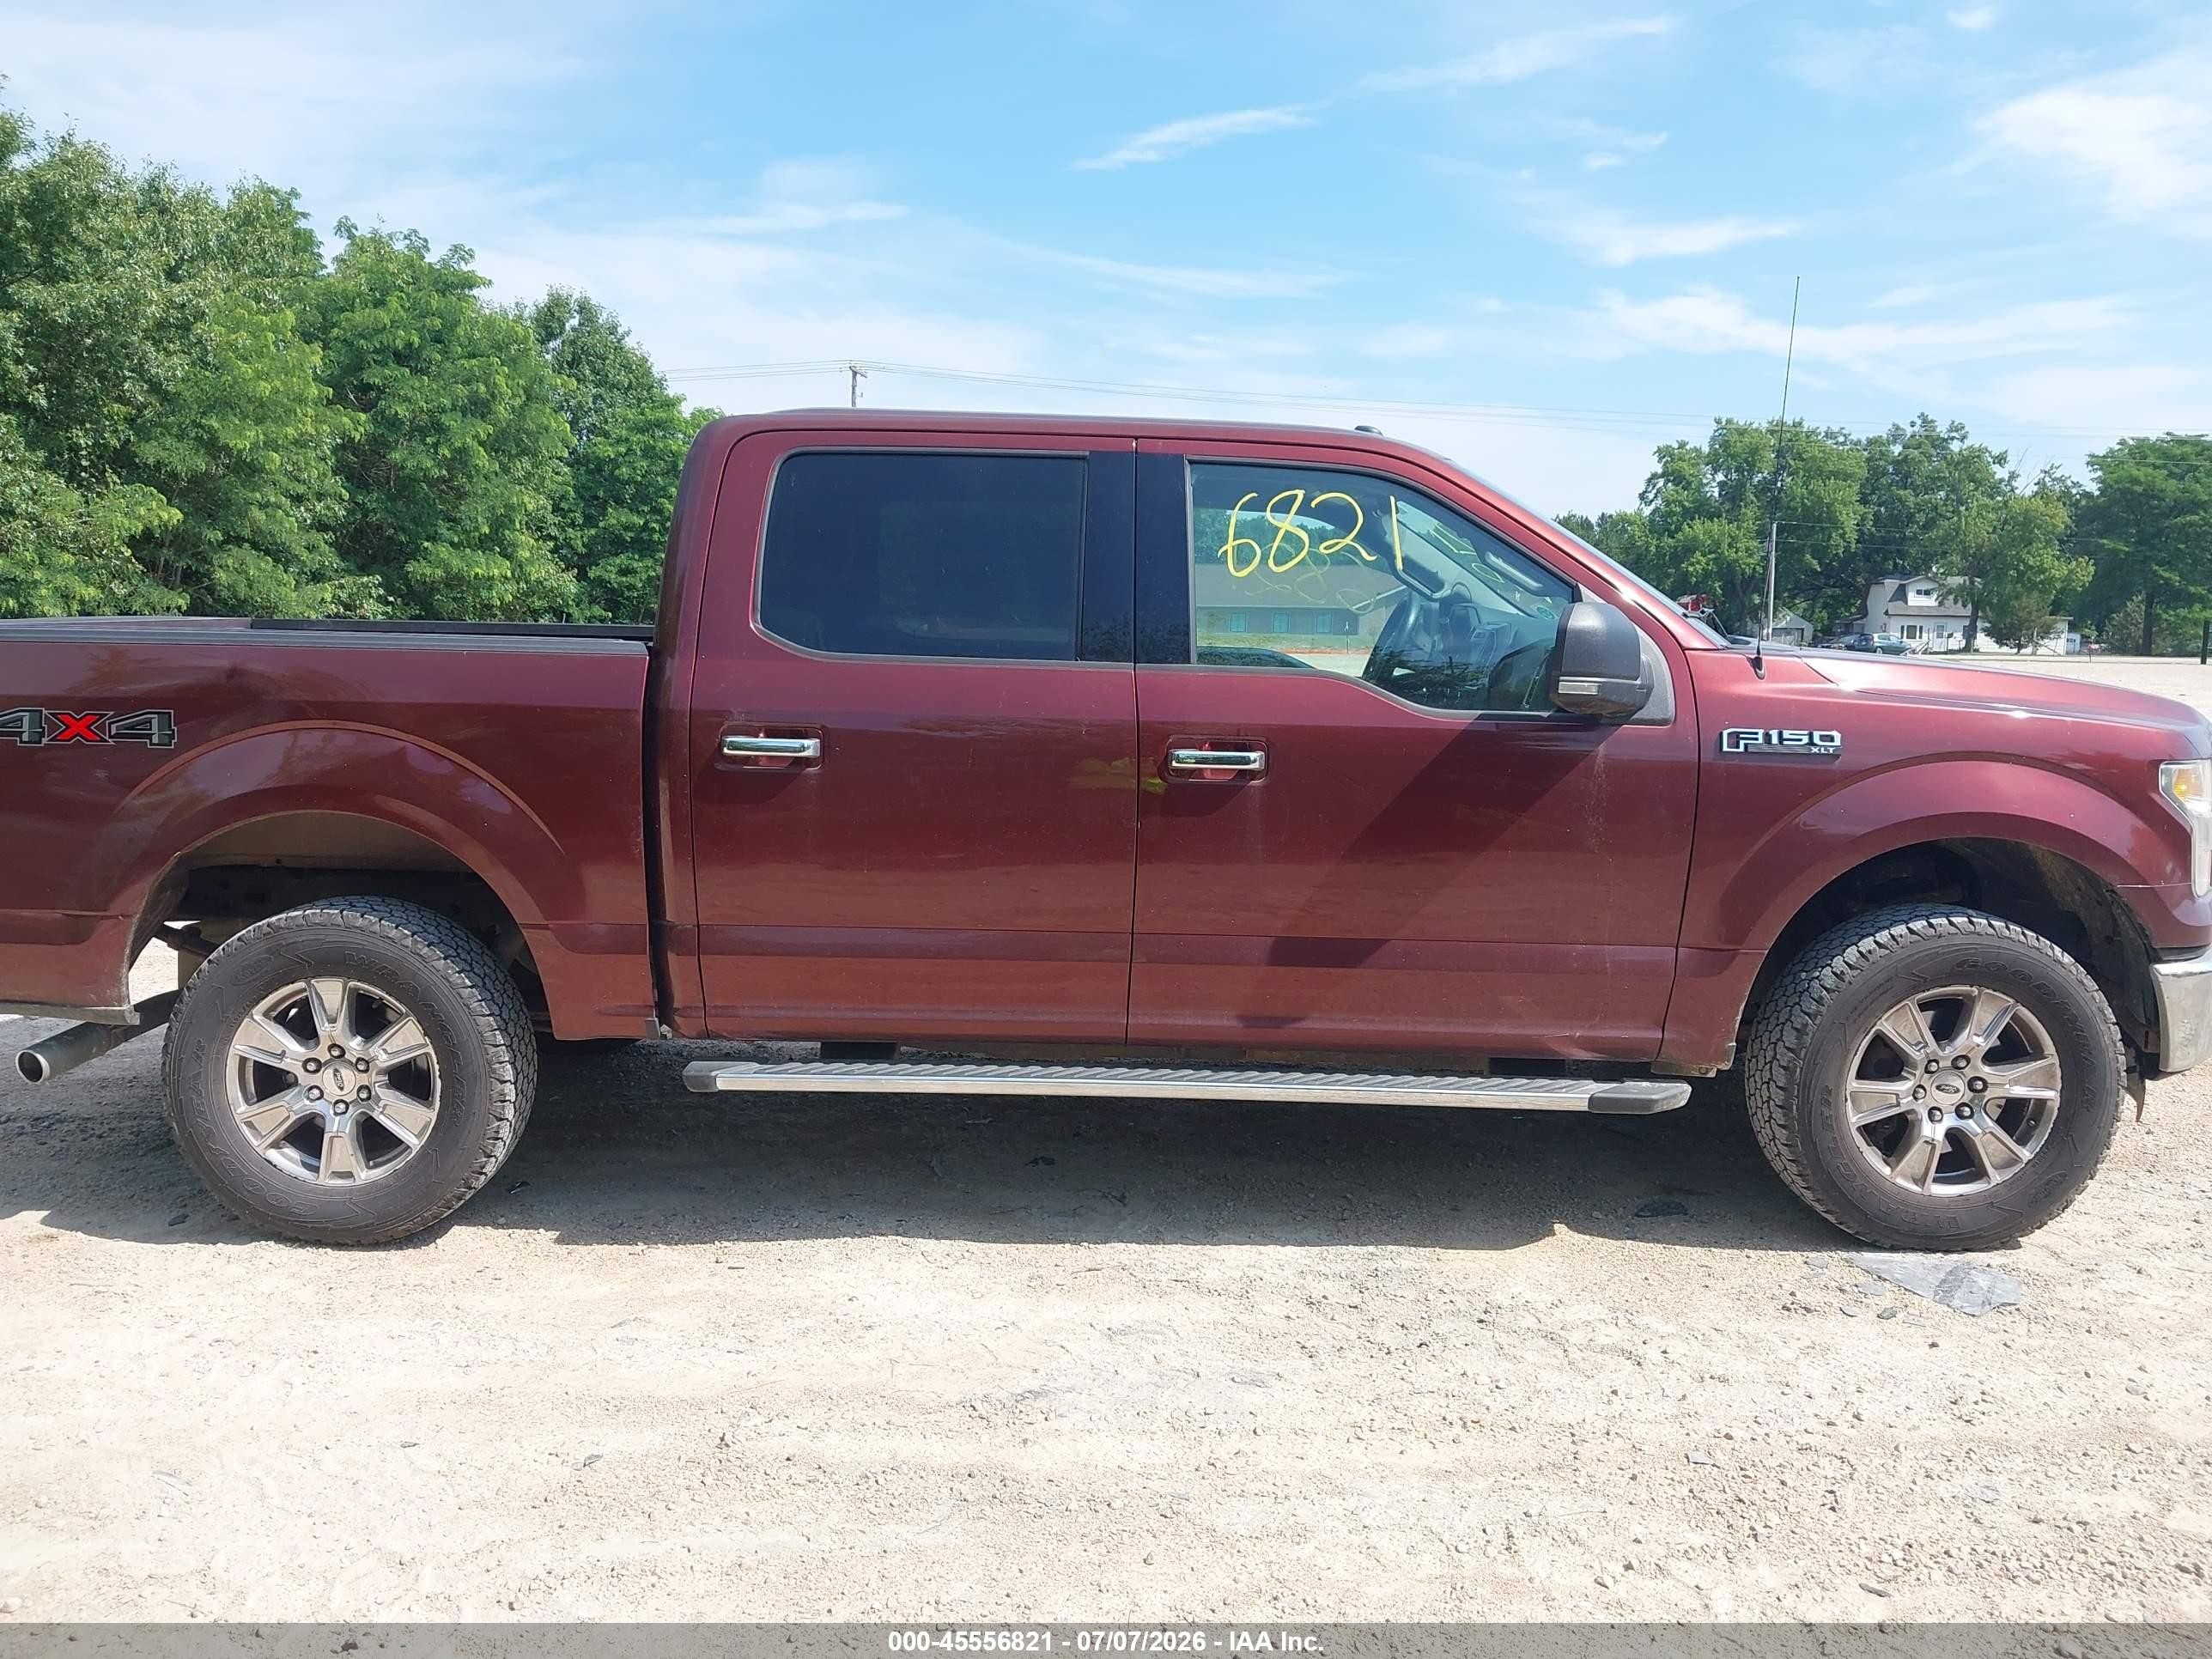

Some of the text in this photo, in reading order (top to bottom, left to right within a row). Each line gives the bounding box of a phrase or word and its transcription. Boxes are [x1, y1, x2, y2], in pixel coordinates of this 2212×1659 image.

[1218, 489, 1404, 579] 6821
[1719, 727, 1842, 752] F150
[1810, 745, 1837, 754] XLT
[186, 1037, 320, 1216] GOODYEAR
